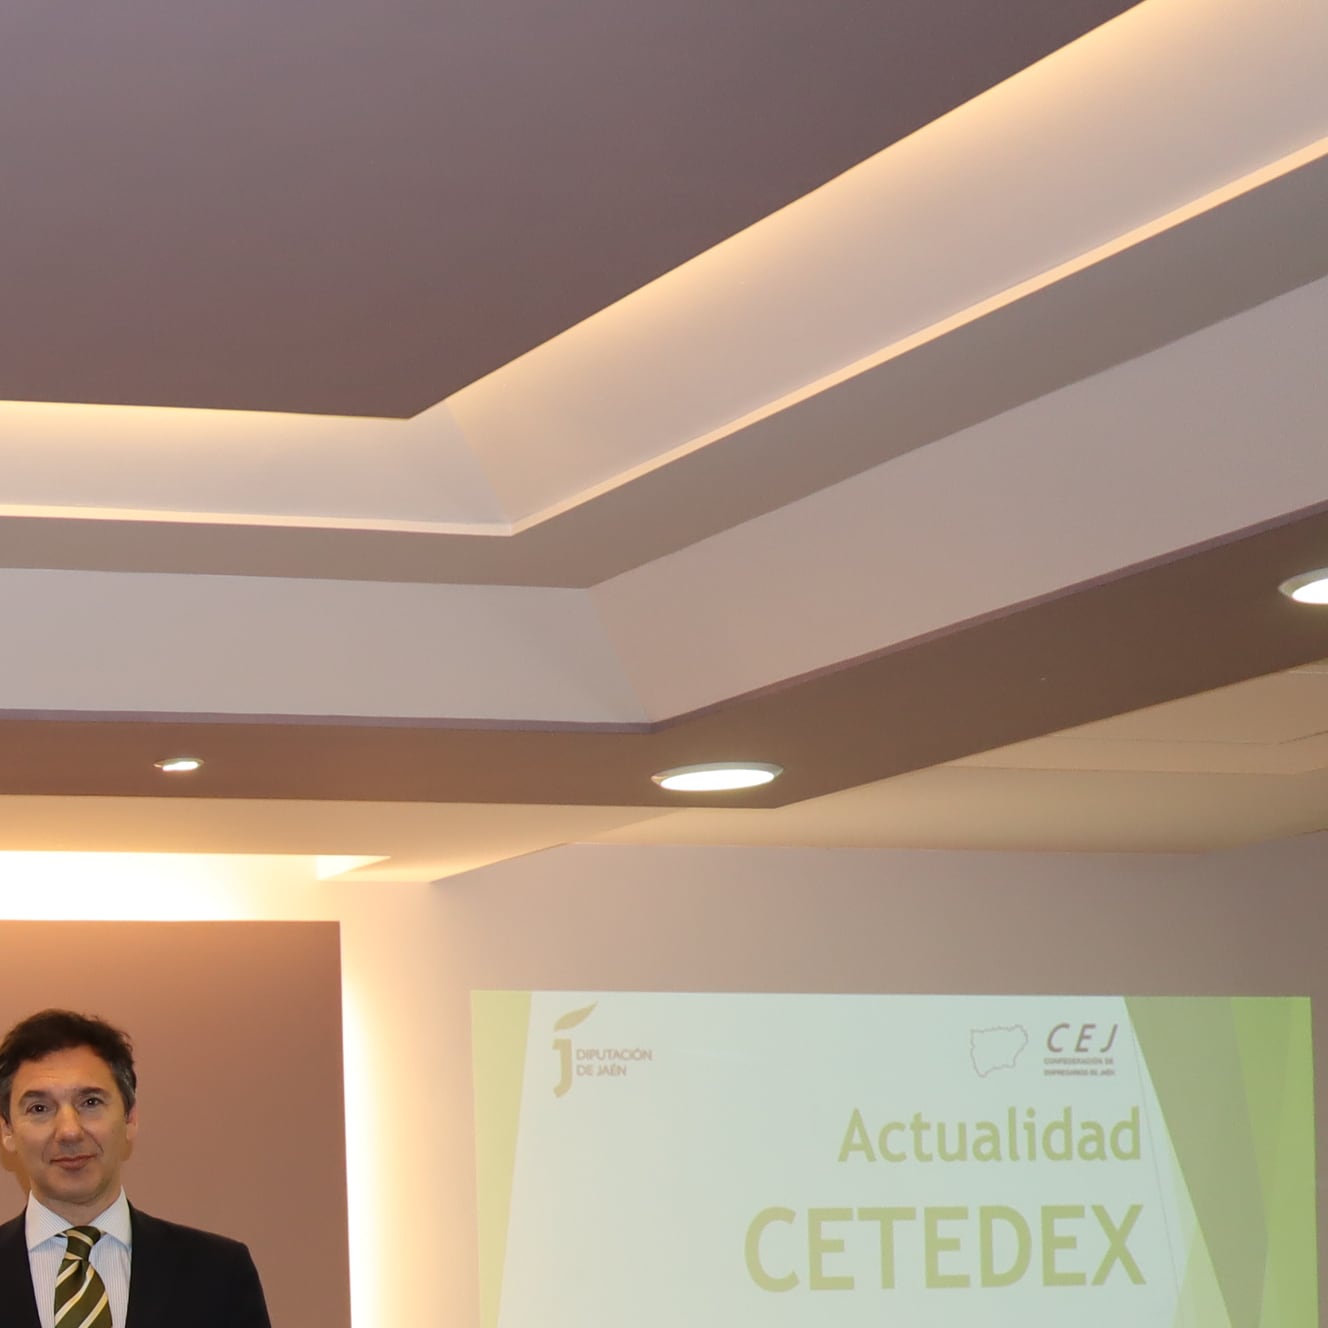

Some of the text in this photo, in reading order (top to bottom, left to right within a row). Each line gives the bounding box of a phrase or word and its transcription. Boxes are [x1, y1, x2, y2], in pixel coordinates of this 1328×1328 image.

[1047, 1022, 1118, 1053] CEJ
[576, 1046, 653, 1061] DIPUTACIÓN
[576, 1062, 627, 1077] DE JAÉN
[838, 1106, 1142, 1163] Actualidad
[744, 1204, 1146, 1293] CETEDEX
